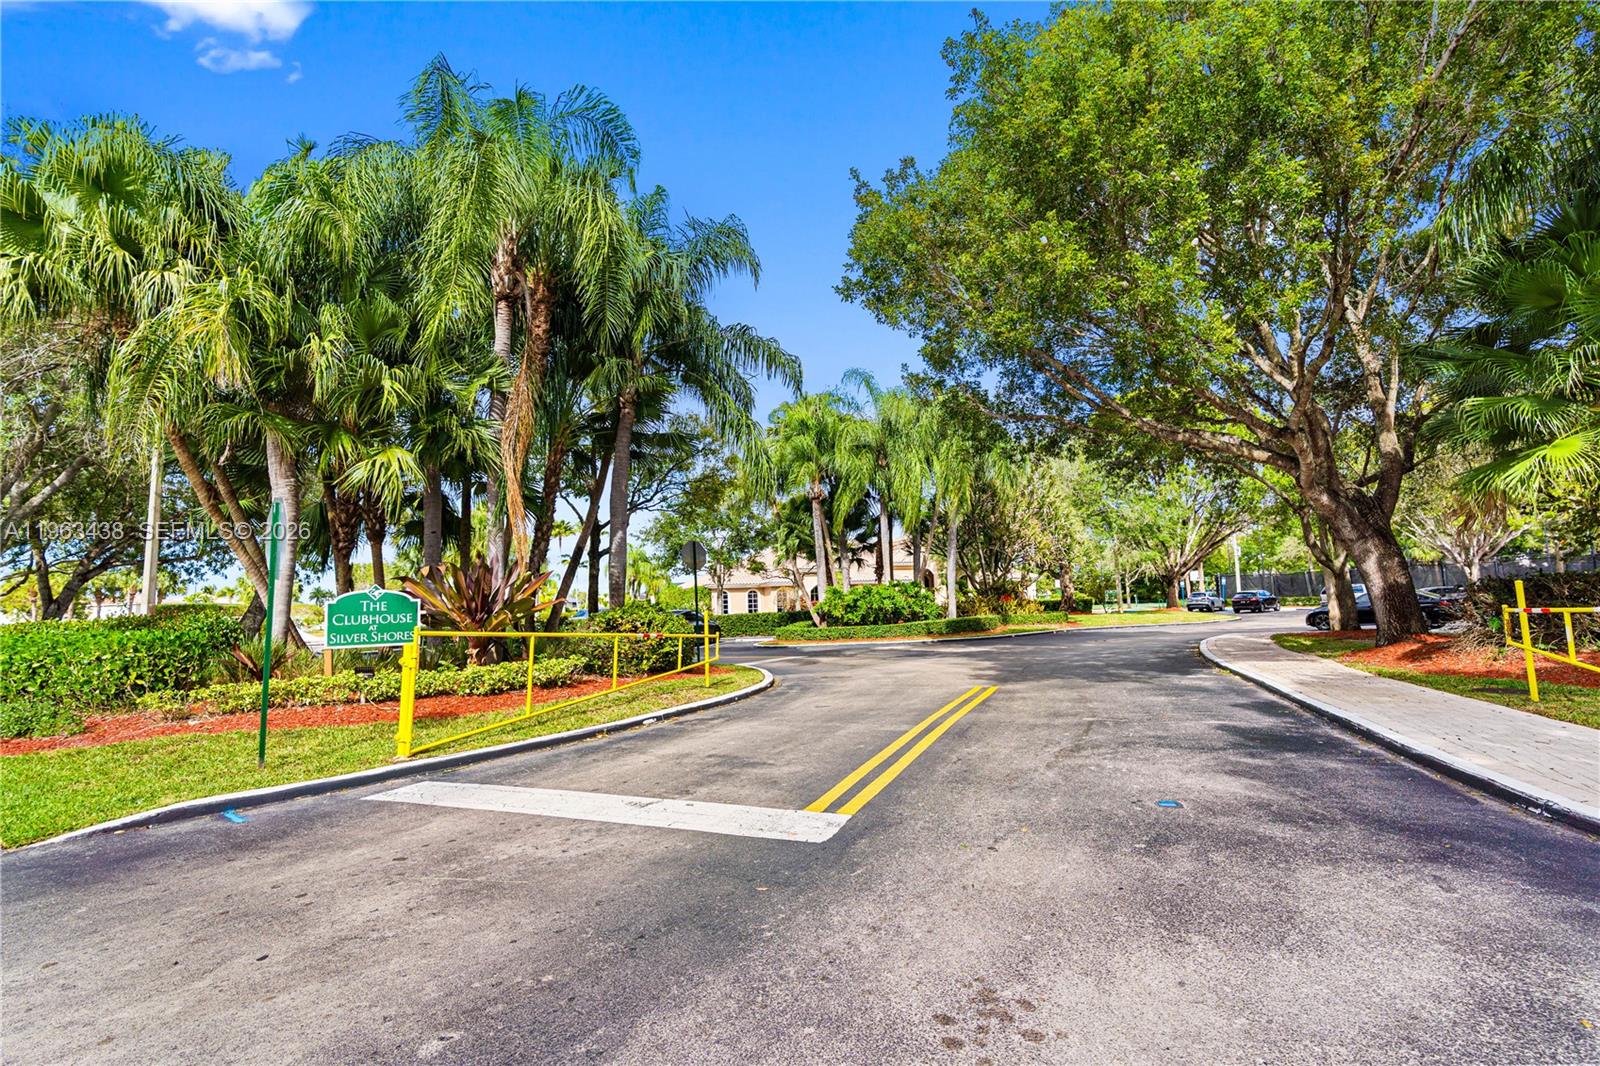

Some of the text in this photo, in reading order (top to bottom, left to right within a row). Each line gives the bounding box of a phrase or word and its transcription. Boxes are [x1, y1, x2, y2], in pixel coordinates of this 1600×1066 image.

[360, 600, 388, 612] THE
[332, 613, 413, 626] CLUBHOUSE
[329, 631, 415, 644] SILVER SHORES
